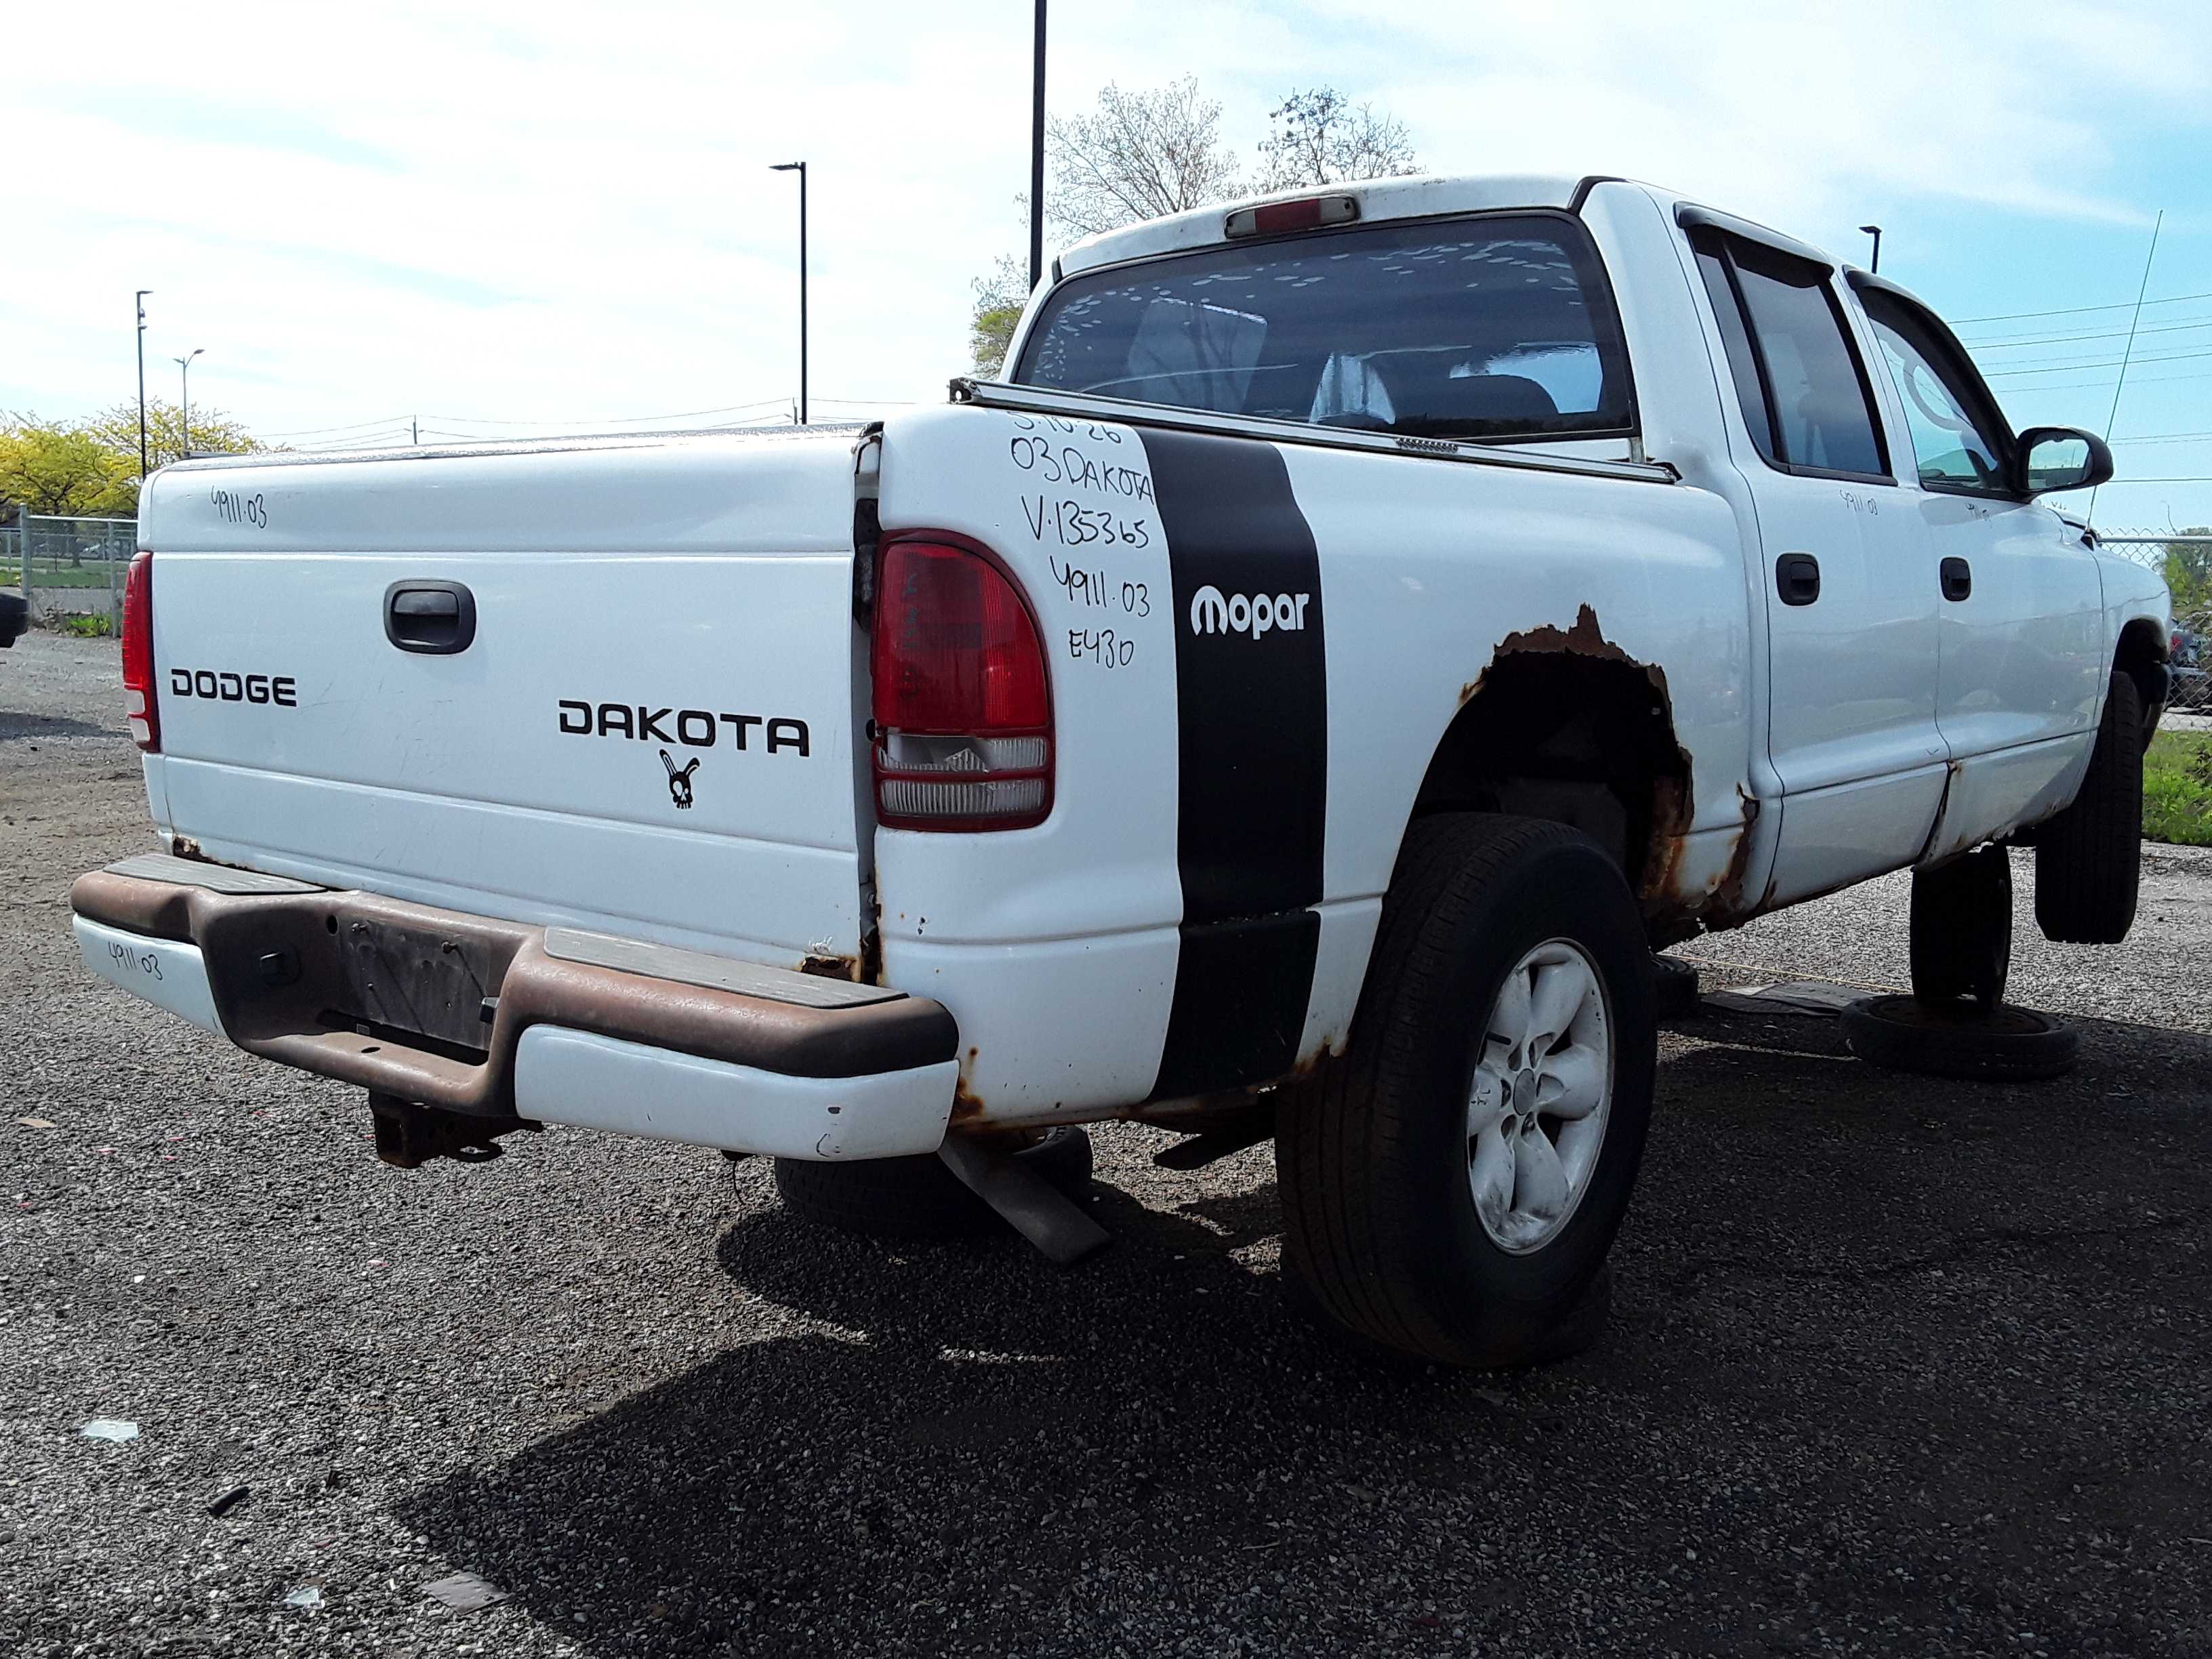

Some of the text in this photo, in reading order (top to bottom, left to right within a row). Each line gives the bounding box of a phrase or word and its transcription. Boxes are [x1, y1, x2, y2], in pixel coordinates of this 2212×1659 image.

[1068, 629, 1134, 669] E430
[171, 668, 298, 708] DODGE
[558, 699, 810, 758] DAKOTA
